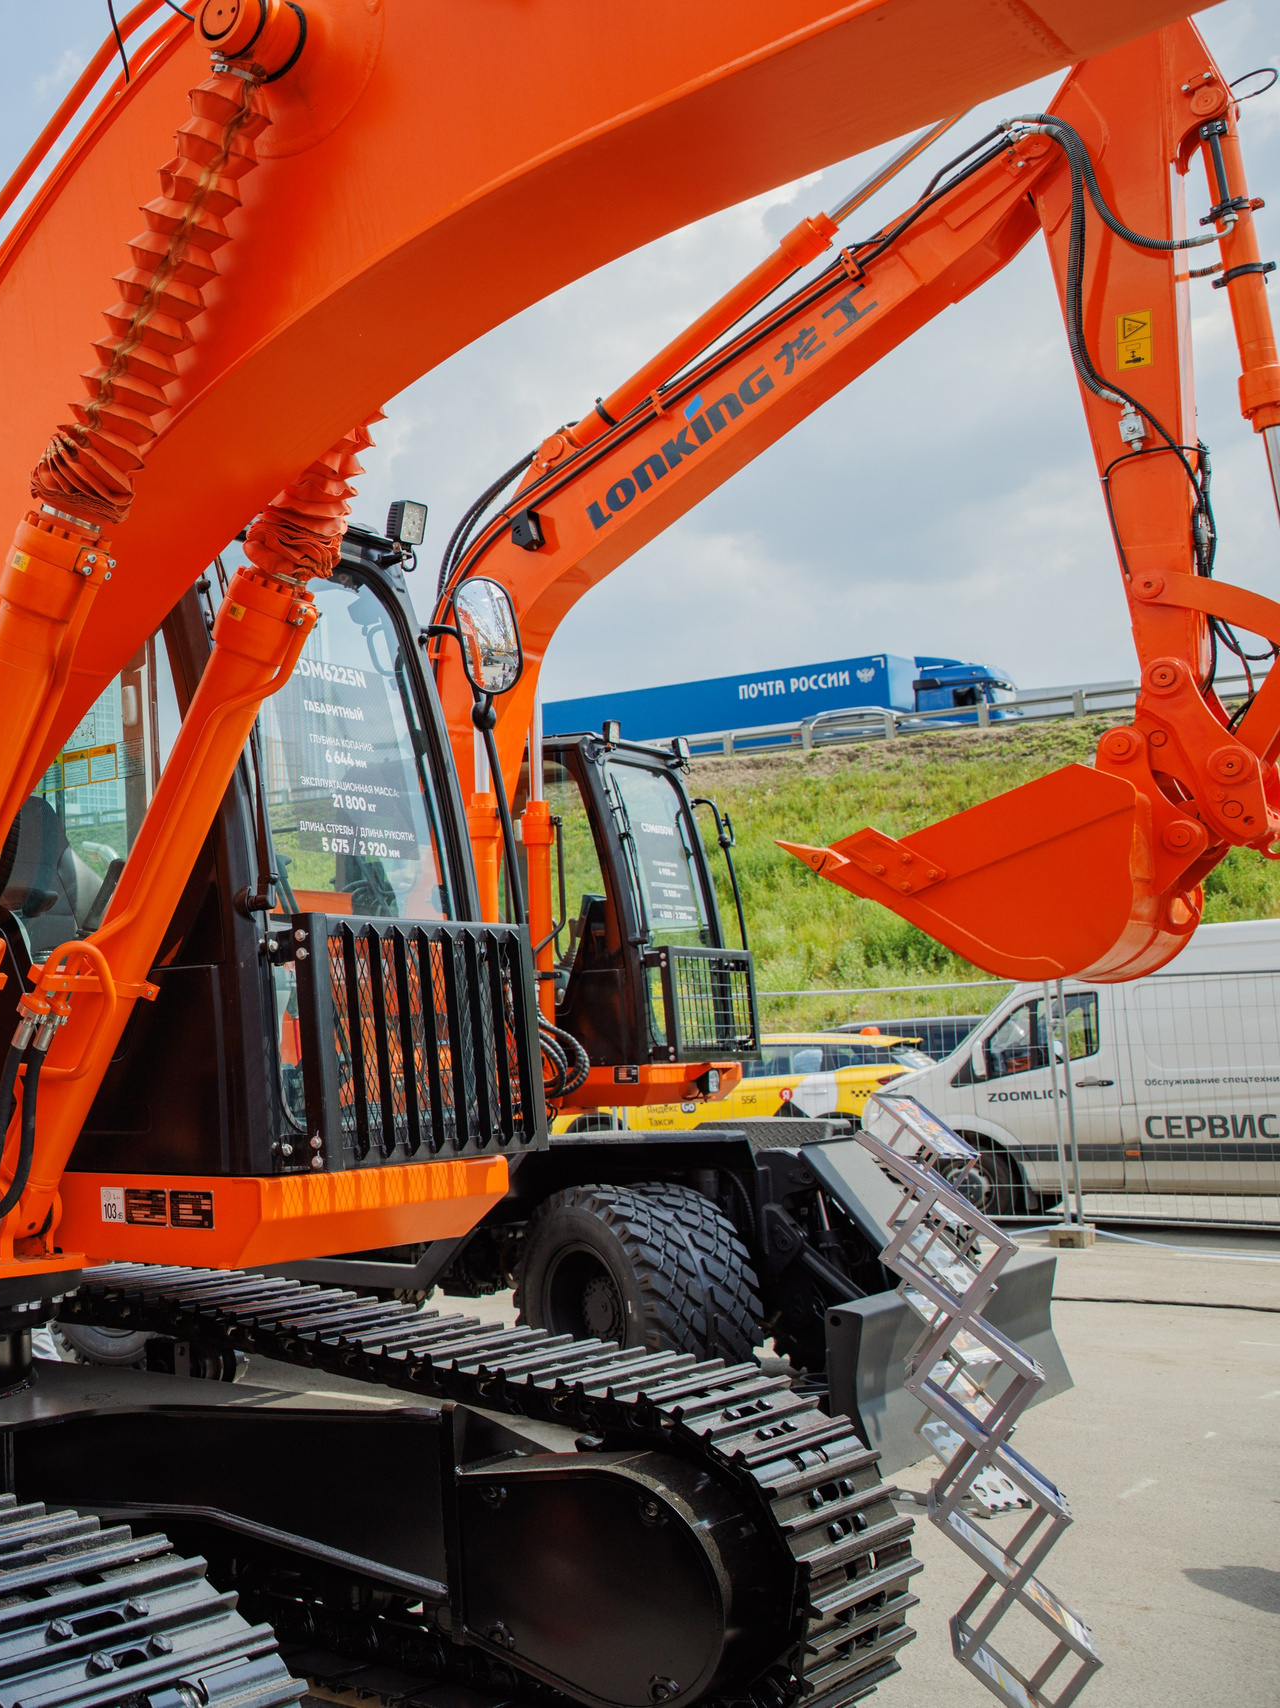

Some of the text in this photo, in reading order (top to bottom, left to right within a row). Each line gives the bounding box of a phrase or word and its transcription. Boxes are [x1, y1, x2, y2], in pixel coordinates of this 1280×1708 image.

[585, 365, 775, 531] LONKING
[738, 670, 850, 700] ПОЧТА РОССИИ
[303, 699, 365, 721] ГАБАРИТНЫЙ
[309, 733, 375, 752] ГЛУБИНА КОПАНИЯ:
[325, 749, 368, 769] 6 644 мм
[300, 775, 374, 794] ЭКСПЛУАТАЦИОННАЯ
[332, 793, 377, 813] 21 800 кг
[300, 820, 325, 833] ДЛИНА
[326, 823, 354, 836] СТРЕЛЫ
[360, 827, 384, 839] ДЛИНА
[322, 837, 330, 852] 5
[331, 838, 349, 854] 675
[359, 840, 367, 855] 2
[368, 842, 388, 857] 920
[388, 848, 401, 858] мм
[1144, 1078, 1220, 1088] Обслуживание
[647, 1102, 696, 1114] Яндекс Go
[741, 1095, 757, 1105] 556
[648, 1117, 674, 1126] Такси
[1144, 1113, 1280, 1139] СЕРВИС
[104, 1202, 117, 1219] 103
